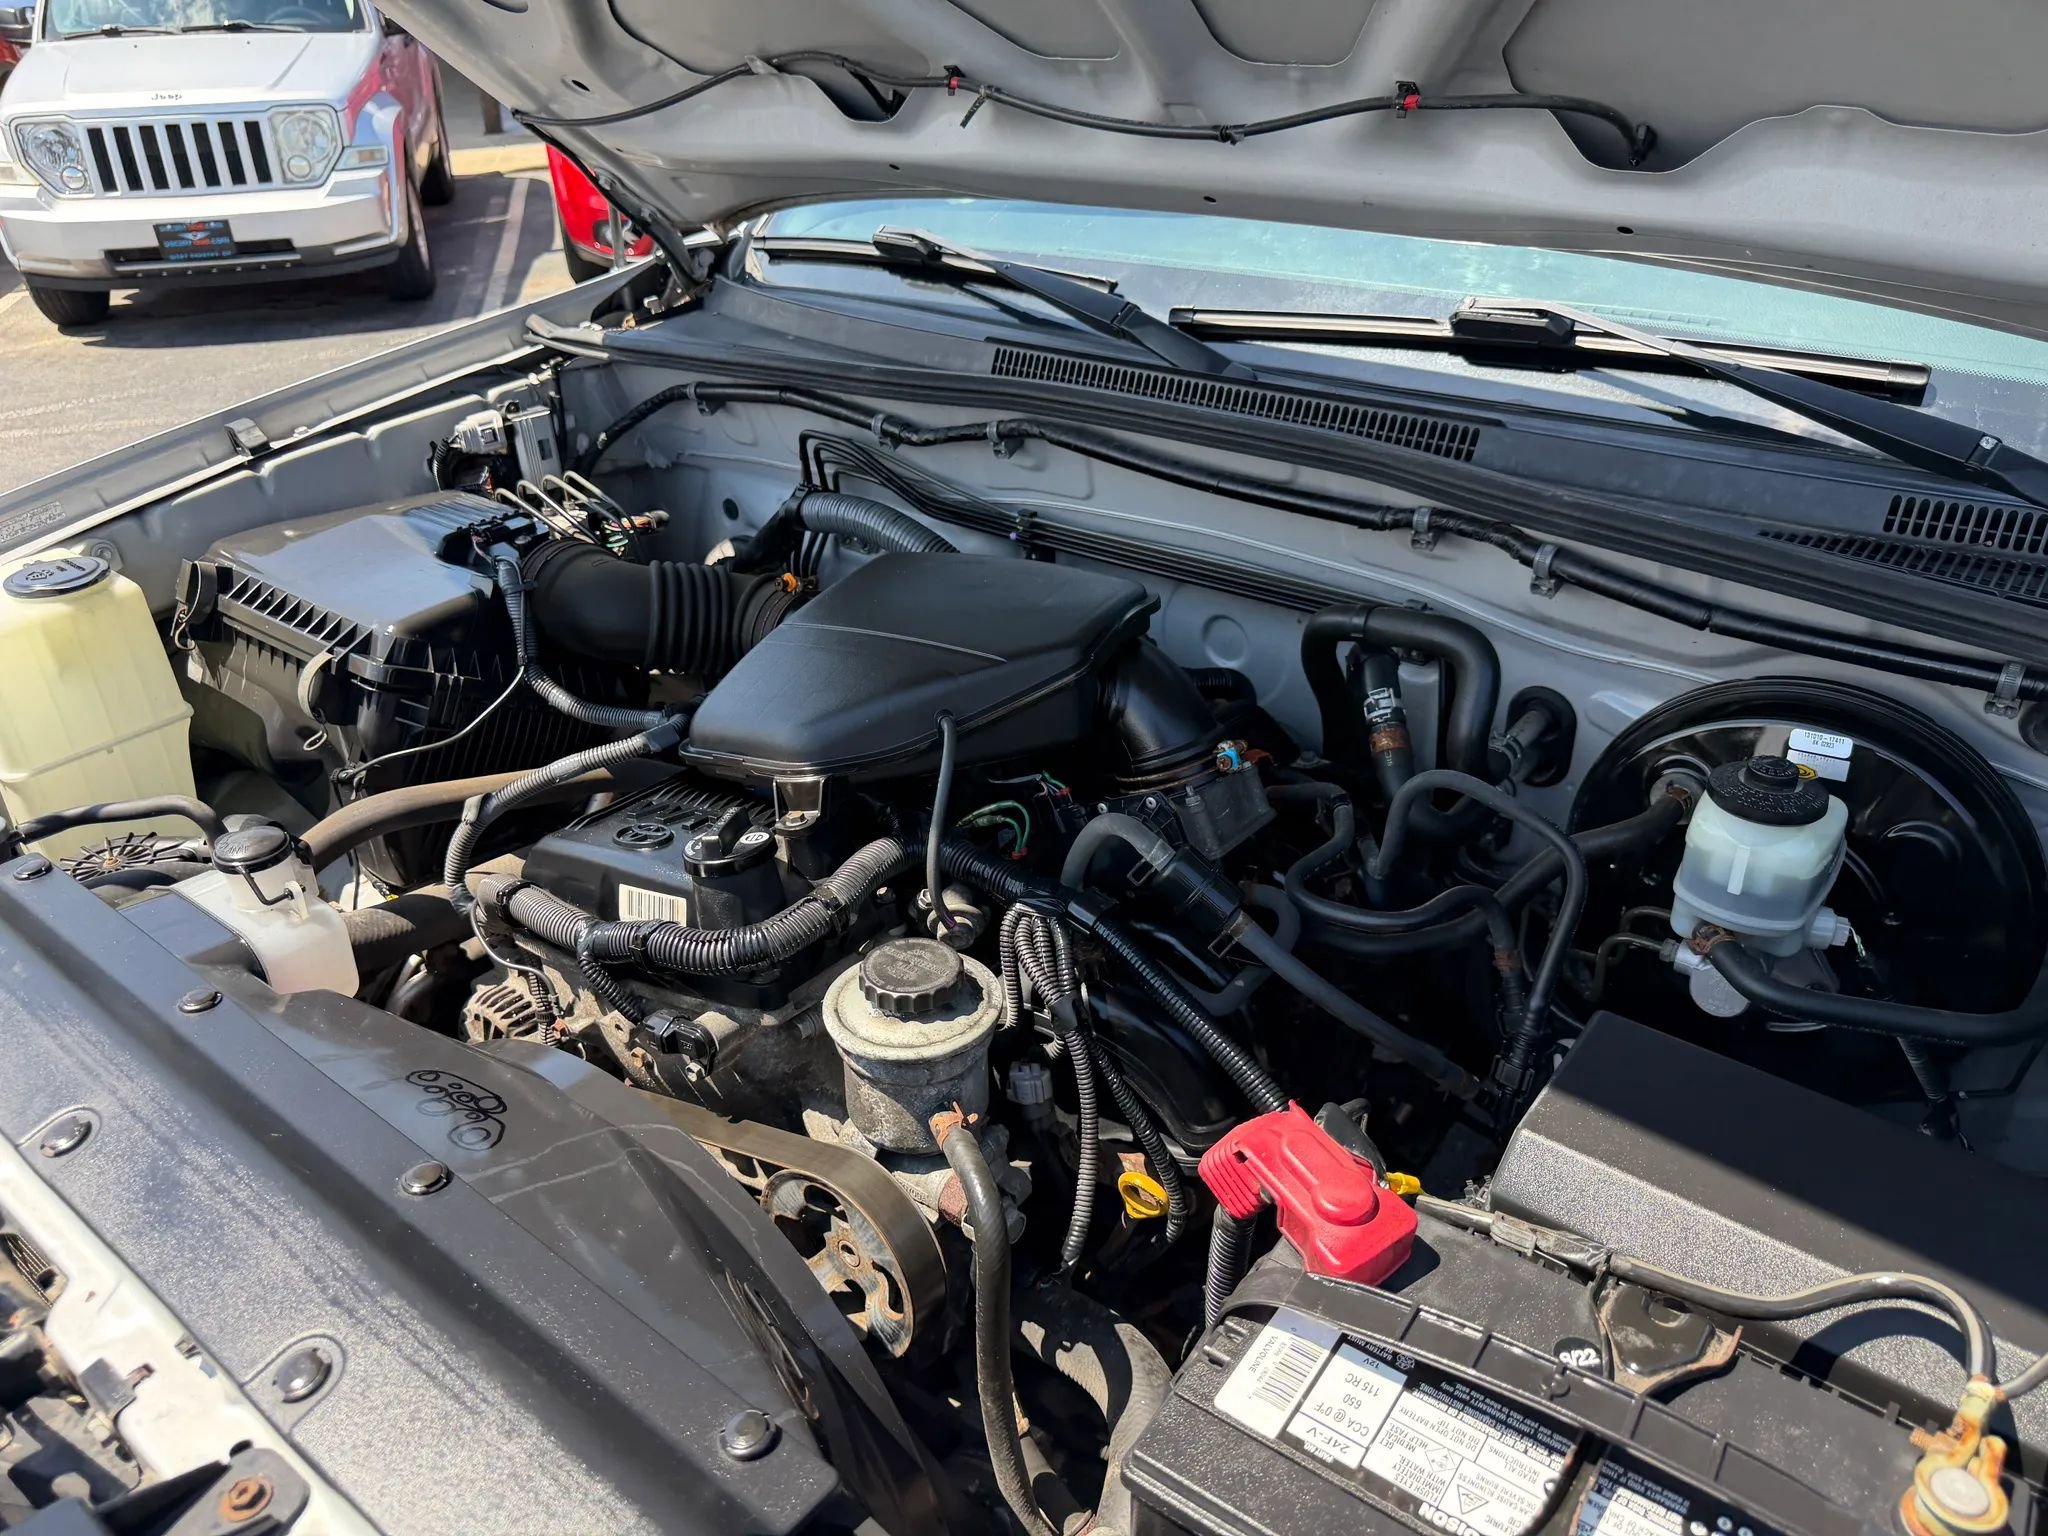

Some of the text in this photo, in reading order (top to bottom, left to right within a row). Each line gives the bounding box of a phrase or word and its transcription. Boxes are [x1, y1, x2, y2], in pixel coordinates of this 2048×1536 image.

[1347, 1333, 1365, 1346] MUST
[1248, 1335, 1278, 1374] VALVOLINE
[1365, 1342, 1392, 1361] BATTERY
[1362, 1356, 1380, 1369] 12V
[1344, 1371, 1381, 1397] 115 RC
[1439, 1380, 1454, 1393] only
[1342, 1392, 1362, 1410] 650
[1453, 1389, 1470, 1401] valid
[1331, 1407, 1347, 1424] @
[1469, 1397, 1506, 1421] WARRANTY
[1344, 1417, 1369, 1437] CCA
[1429, 1422, 1449, 1437] OPEN
[1451, 1425, 1466, 1438] NOT
[1506, 1416, 1534, 1435] LIMITED
[1305, 1424, 1350, 1454] 24F-V
[1379, 1436, 1394, 1449] GET
[1382, 1429, 1417, 1452] MEDICAL
[1387, 1422, 1428, 1449] HELP FAST.
[1448, 1433, 1465, 1446] NOT
[1468, 1434, 1480, 1445] DO
[1464, 1441, 1476, 1452] DO
[1485, 1443, 1540, 1478] INSTRUCTIONS.
[1391, 1462, 1442, 1494] IMMEDIATELY
[1425, 1471, 1447, 1487] WITH
[1502, 1461, 1537, 1484] READ ALL
[1393, 1473, 1438, 1502] FLUSH EYES
